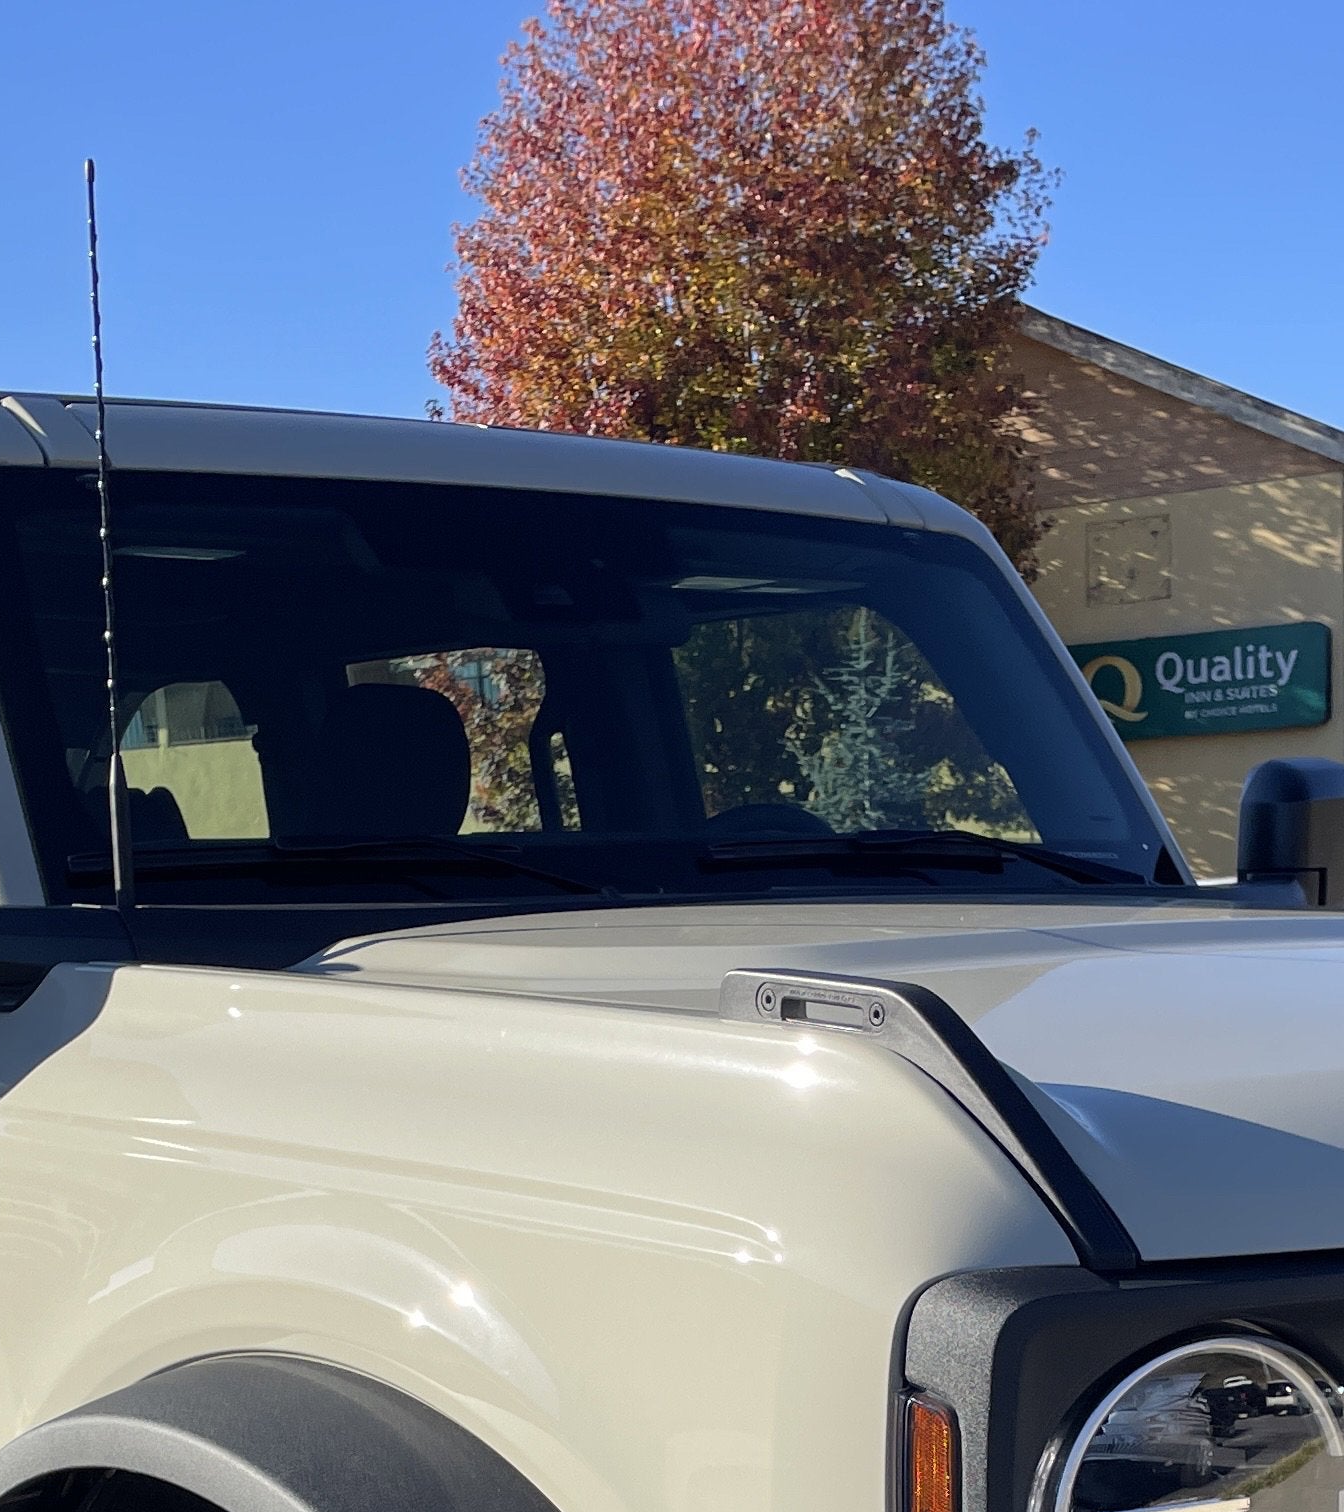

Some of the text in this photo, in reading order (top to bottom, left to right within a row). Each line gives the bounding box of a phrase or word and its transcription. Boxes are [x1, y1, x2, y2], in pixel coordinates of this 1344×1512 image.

[1083, 656, 1148, 722] Q
[1155, 644, 1299, 694] Quality
[1225, 684, 1278, 700] SUITES
